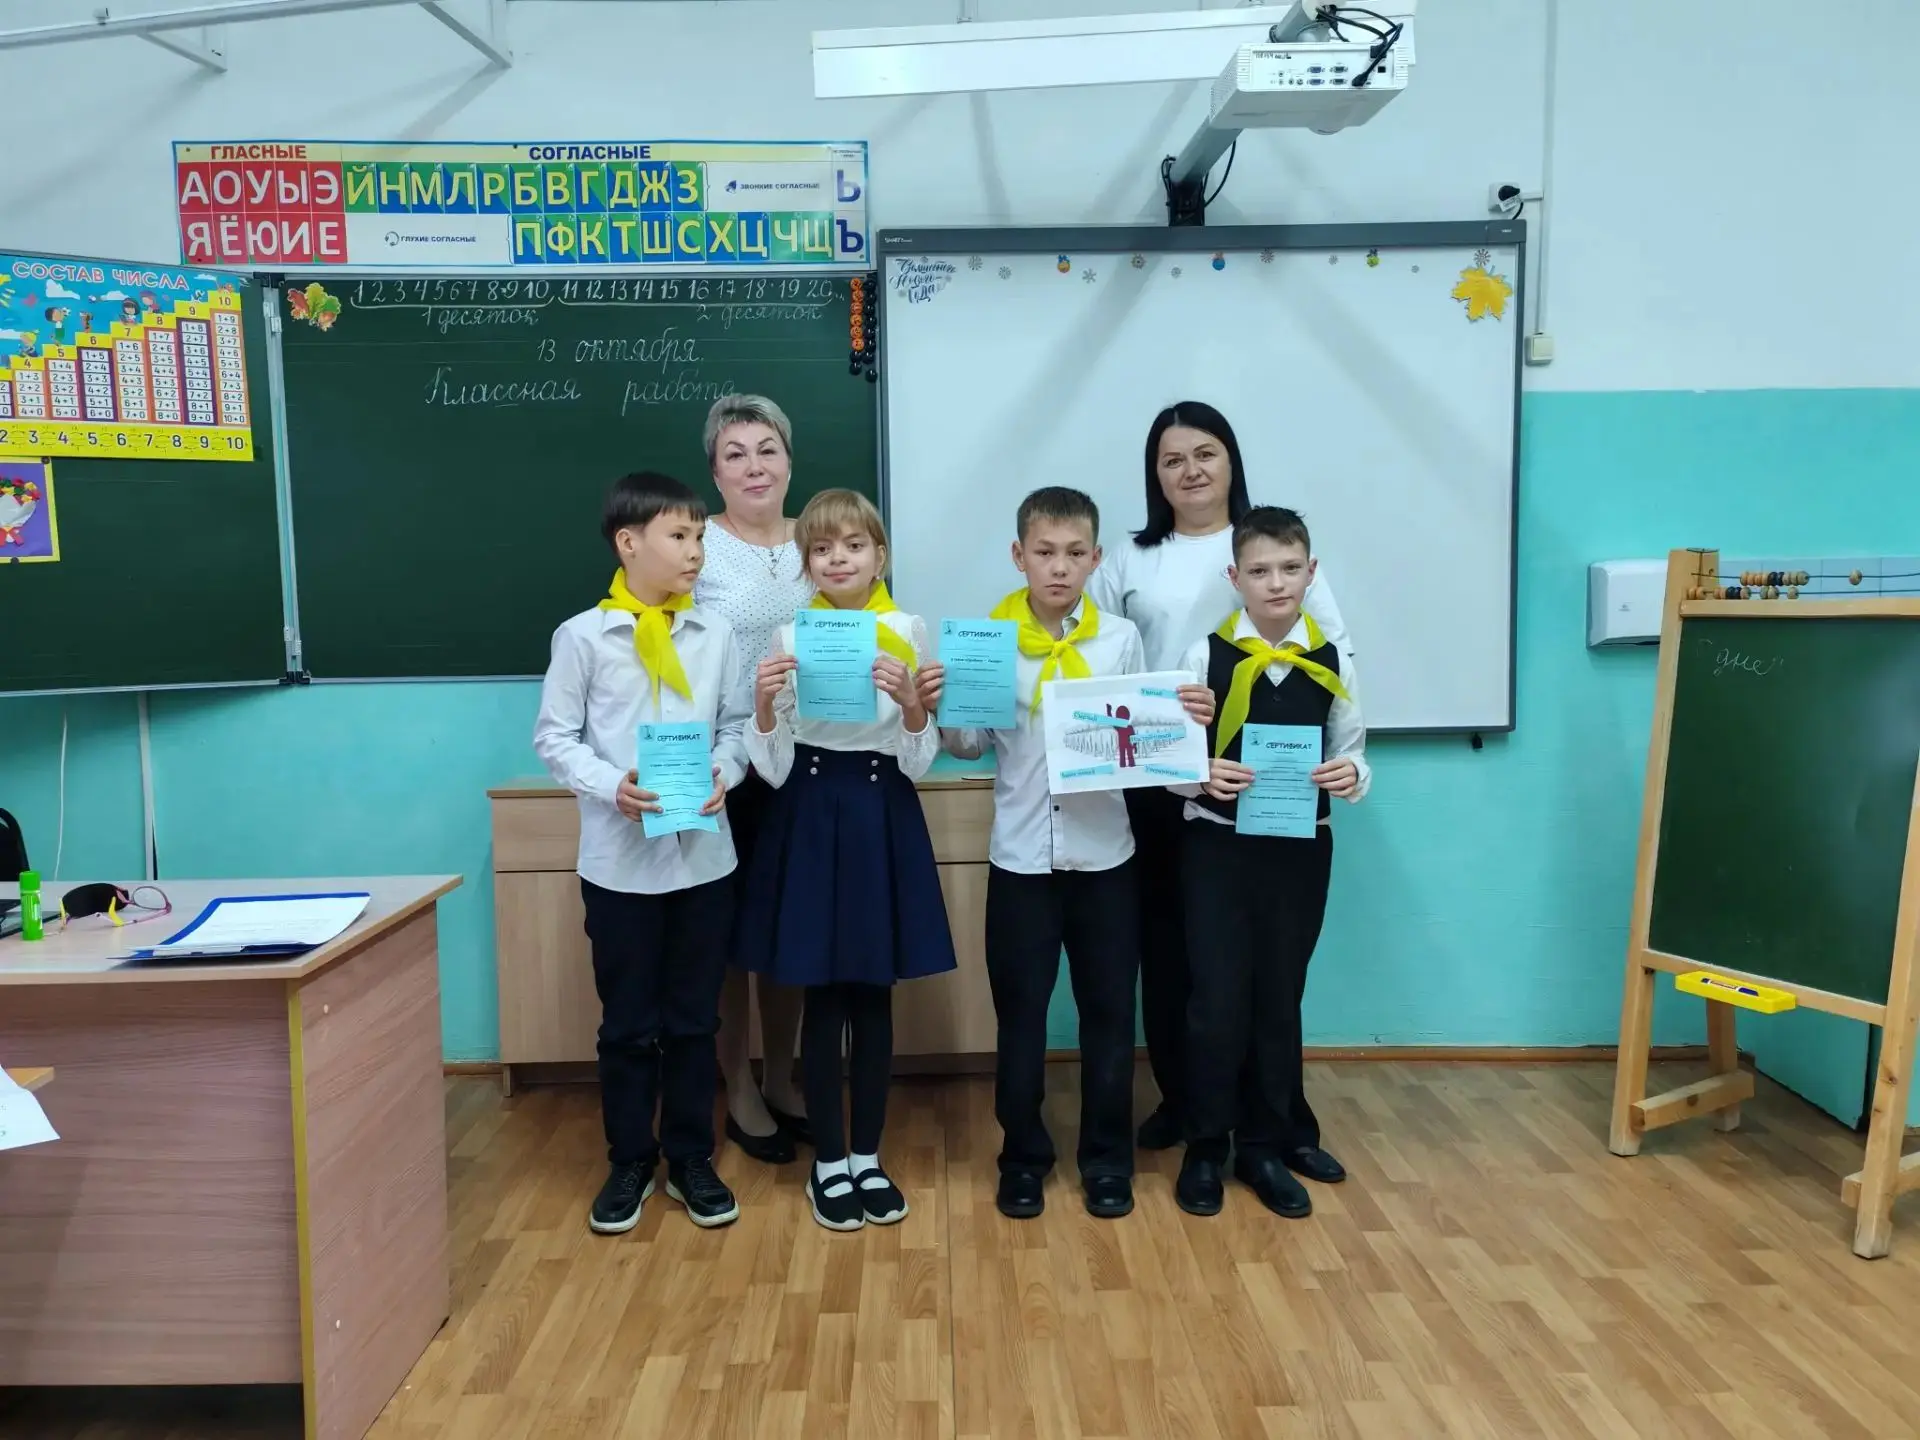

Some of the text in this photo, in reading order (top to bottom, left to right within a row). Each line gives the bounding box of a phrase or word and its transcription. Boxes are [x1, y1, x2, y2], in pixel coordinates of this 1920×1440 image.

[211, 145, 307, 159] ГЛАСНЫЕ
[529, 146, 651, 161] СОГЛАСНЫЕ
[775, 182, 820, 190] СОГЛАСНЫЕ
[401, 235, 476, 243] ГЛУХИЕ СОГЛАСНЫЕ
[12, 262, 189, 291] СОСТАВ ЧИСЛА
[355, 281, 364, 302] 1
[372, 280, 385, 302] 2
[394, 281, 406, 302] 3
[413, 281, 428, 300] 4
[433, 280, 446, 300] 5
[450, 280, 460, 300] 6
[466, 280, 479, 300] 7
[487, 280, 500, 300] 8
[504, 280, 519, 298] 9
[523, 280, 549, 299] 10
[561, 280, 578, 299] 11
[586, 280, 602, 300] 12
[609, 280, 628, 300] 13
[633, 280, 653, 300] 14
[661, 280, 682, 299] 15
[688, 280, 709, 300] 16
[717, 280, 735, 298] 17
[743, 280, 765, 300] 18
[779, 279, 800, 298] 19
[219, 297, 231, 305] 10
[189, 307, 196, 315] 9
[422, 306, 539, 334] 1 десяток
[697, 304, 822, 329] 2 десяток
[125, 328, 131, 336] 7
[90, 336, 97, 345] 6
[58, 349, 64, 357] 5
[537, 339, 556, 362] 13
[24, 359, 31, 368] 4
[425, 367, 581, 407] Классная
[28, 430, 38, 443] 3
[58, 432, 68, 444] 4
[88, 432, 97, 445] 5
[117, 433, 127, 446] 6
[144, 434, 153, 446] 7
[172, 435, 182, 448] 8
[200, 436, 209, 448] 9
[227, 437, 243, 449] 10
[657, 733, 701, 742] СЕРТИФИКАТ
[1266, 742, 1312, 750] СЕРТИФИКАТ
